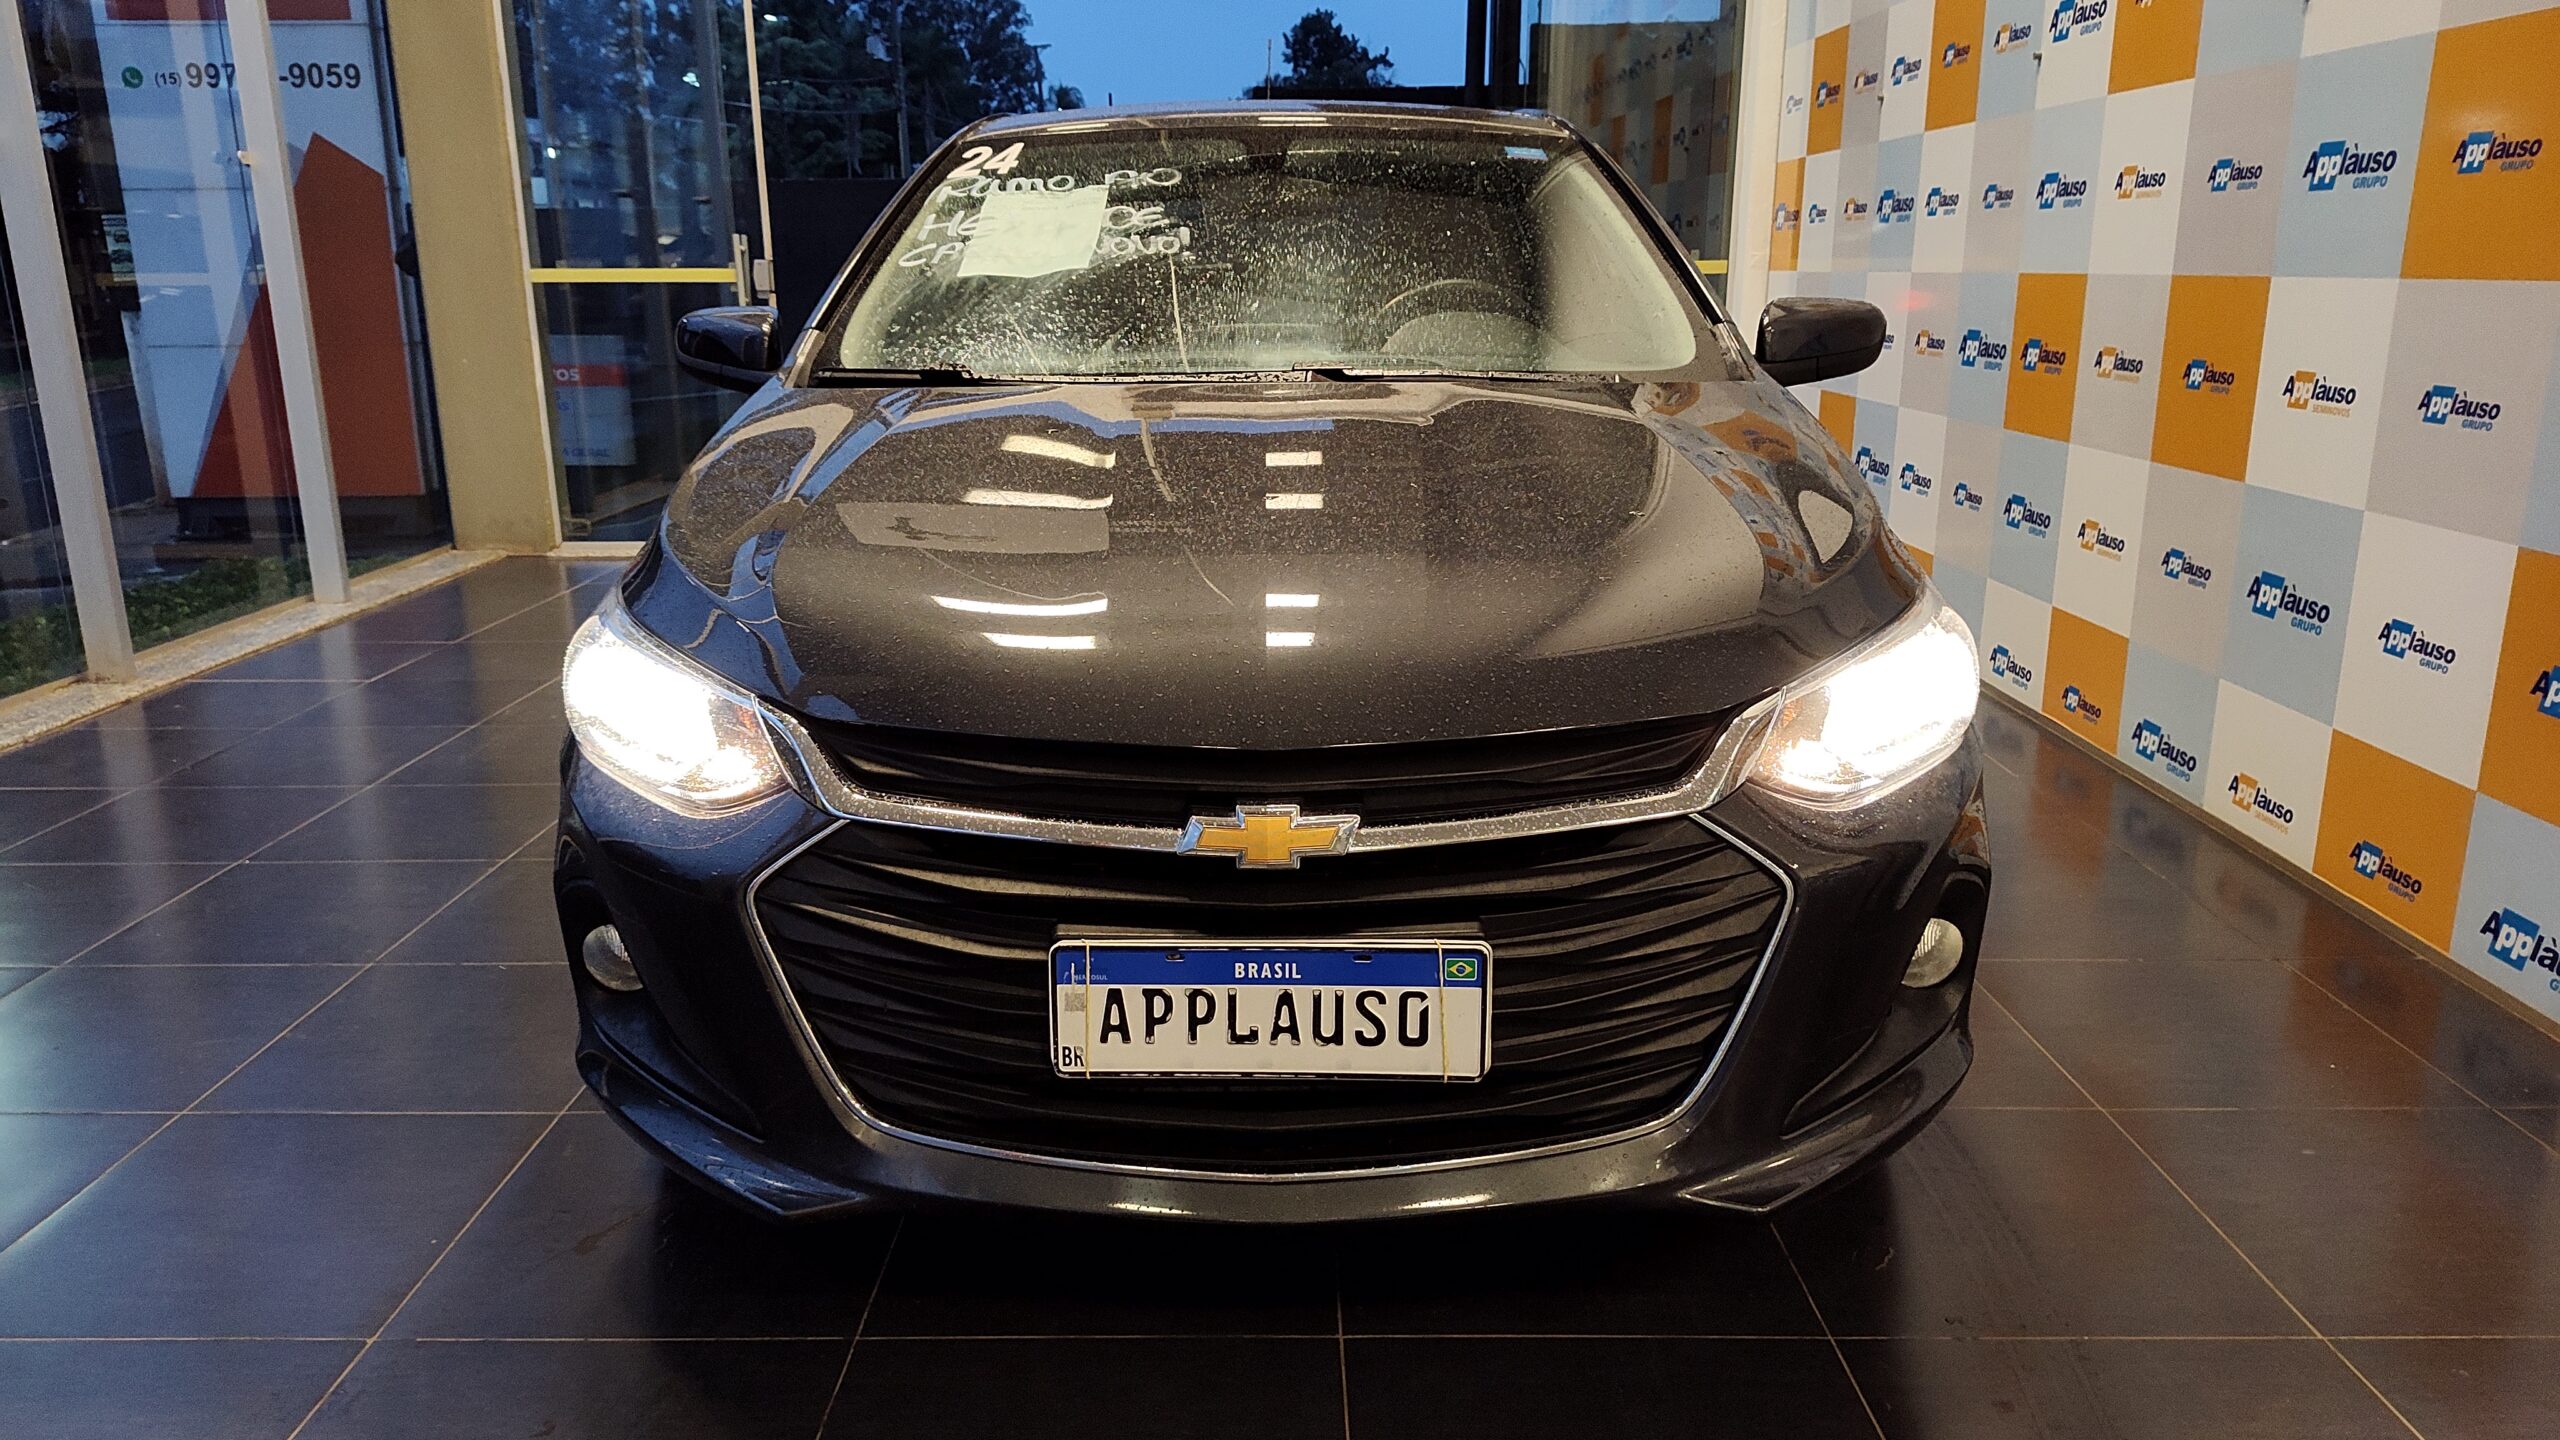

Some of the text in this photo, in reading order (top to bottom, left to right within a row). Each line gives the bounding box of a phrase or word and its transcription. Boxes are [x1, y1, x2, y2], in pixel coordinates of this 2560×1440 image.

[155, 72, 182, 88] (15)
[946, 142, 1025, 179] 24
[2352, 175, 2388, 190] GRUPO
[2461, 418, 2493, 432] GRUPO
[2290, 616, 2323, 636] GRUPO
[2419, 657, 2449, 674] GRUPO
[1234, 962, 1302, 979] BRASIL
[1099, 987, 1430, 1047] APPLAUSO
[1062, 1045, 1085, 1068] BR
